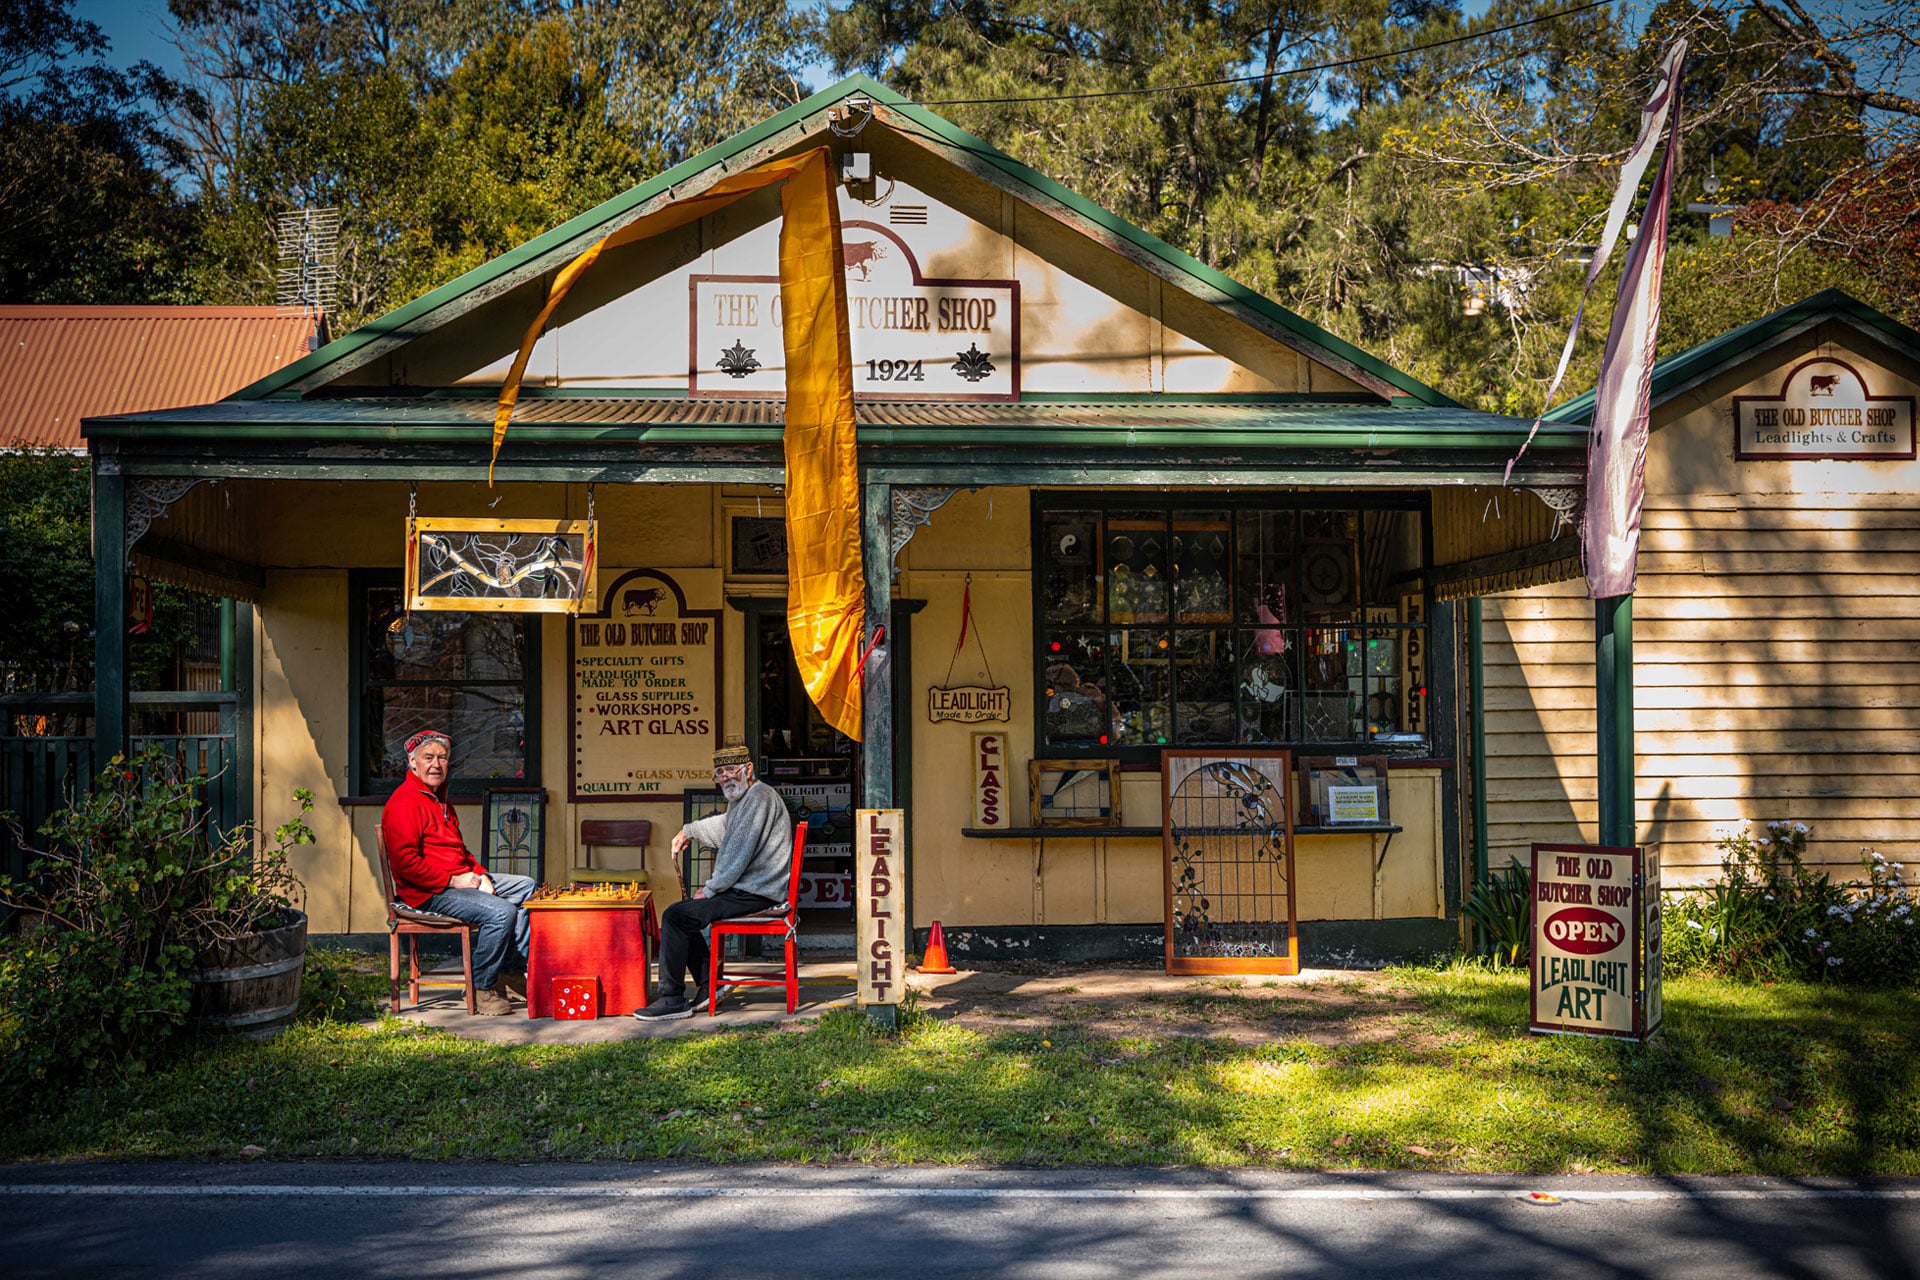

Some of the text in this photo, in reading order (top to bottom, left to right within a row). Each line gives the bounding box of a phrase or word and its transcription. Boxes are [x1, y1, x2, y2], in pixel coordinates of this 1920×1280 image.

[714, 293, 759, 327] THE
[850, 296, 931, 332] TCHER
[938, 297, 997, 333] SHOP
[866, 358, 925, 382] 1924
[1754, 408, 1896, 427] THE OLD BUTCHER SHOP
[1756, 431, 1896, 446] Leadlights & Crafts
[580, 622, 708, 647] THE OLD BUTCHER SHOP
[582, 656, 685, 667] SPECIALTY GIFTS
[582, 670, 656, 679] LEADLIGHTS
[582, 678, 686, 688] MADE TO ORDER
[596, 691, 694, 701] GLASS SUPPLIES
[933, 693, 1005, 710] LEADLIGHT
[596, 703, 691, 716] WORKSHOPS
[936, 711, 1002, 719] Made to Order
[600, 719, 709, 736] ART GLASS
[635, 770, 713, 780] GLASS VASES
[980, 736, 1002, 825] GLASS
[583, 782, 661, 793] QUALITY ART
[823, 846, 836, 854] TO
[1556, 856, 1613, 879] THE OLD
[1538, 882, 1592, 905] BUTCHER
[1598, 885, 1632, 907] SHOP
[870, 815, 892, 1001] LEADLIGHT
[1550, 920, 1620, 943] OPEN
[1541, 956, 1628, 997] LEADLIGHT
[1555, 986, 1607, 1021] ART
